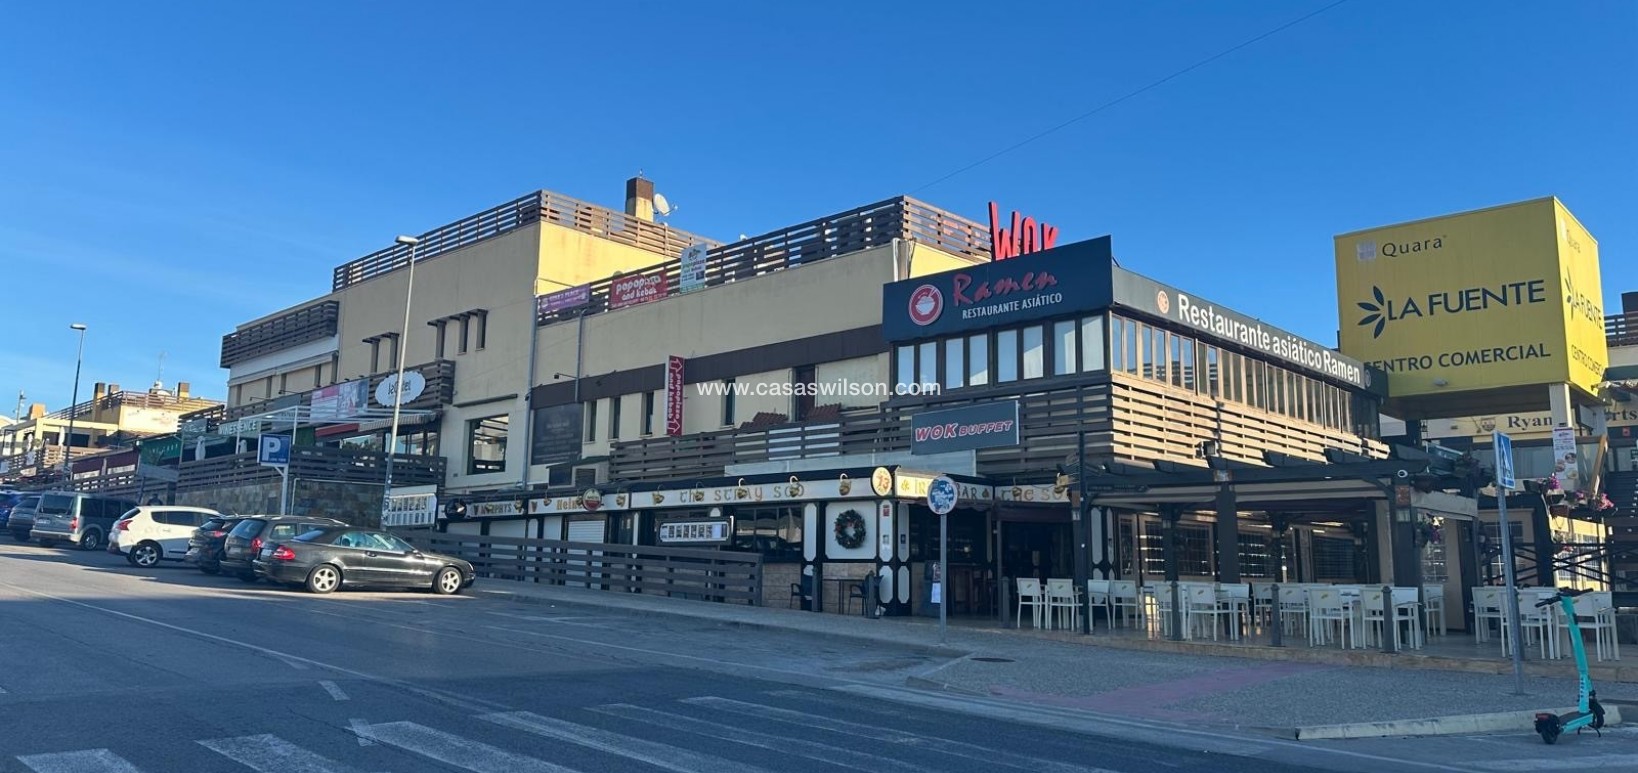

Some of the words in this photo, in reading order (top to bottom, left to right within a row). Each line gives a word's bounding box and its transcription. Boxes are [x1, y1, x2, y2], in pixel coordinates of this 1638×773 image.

[988, 201, 1058, 261] WOK
[1382, 237, 1442, 258] Quara
[953, 272, 1057, 307] Ramen
[1387, 297, 1423, 320] LA
[1428, 279, 1546, 316] FUENTE
[962, 300, 1019, 319] RESTAURANTE
[1021, 292, 1062, 310] ASIÁTICO
[1178, 293, 1270, 350] Restaurante
[1272, 335, 1322, 369] asiático
[1323, 350, 1360, 384] Ramen
[1438, 343, 1551, 368] COMERCIAL
[915, 422, 958, 441] WOK
[959, 420, 1013, 437] BUFFET
[262, 436, 281, 461] P
